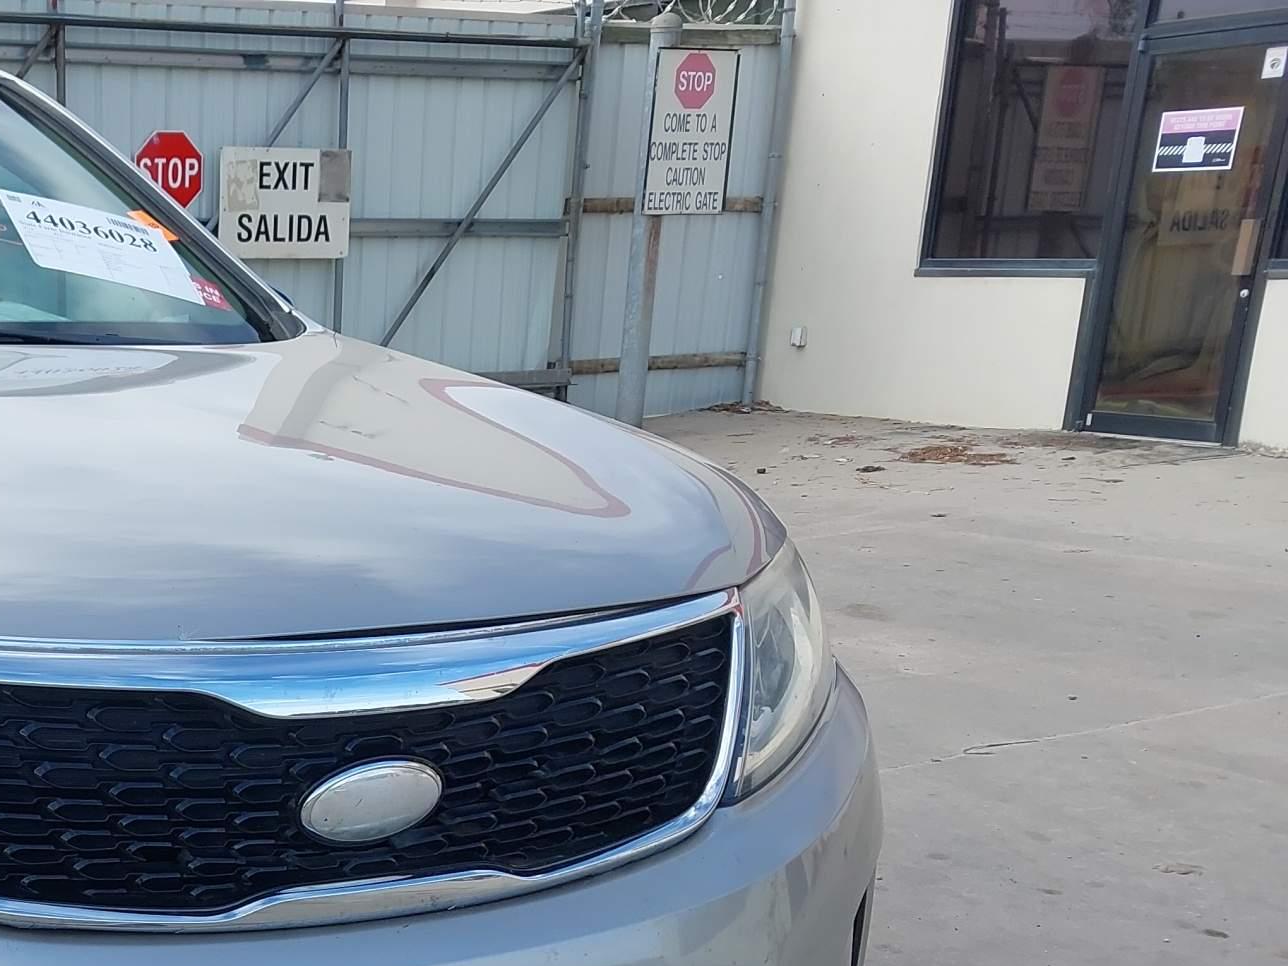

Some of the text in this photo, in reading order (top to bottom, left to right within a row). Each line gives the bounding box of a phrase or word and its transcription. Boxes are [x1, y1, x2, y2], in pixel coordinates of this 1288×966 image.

[678, 71, 713, 91] STOP
[664, 113, 717, 133] COME TO A
[650, 142, 727, 161] COMPLETE STOP
[258, 160, 314, 191] EXIT
[665, 167, 705, 186] CAUTION
[647, 192, 718, 210] ELECTRIC GATE
[25, 210, 158, 253] 44036028
[236, 213, 331, 244] SALIDA
